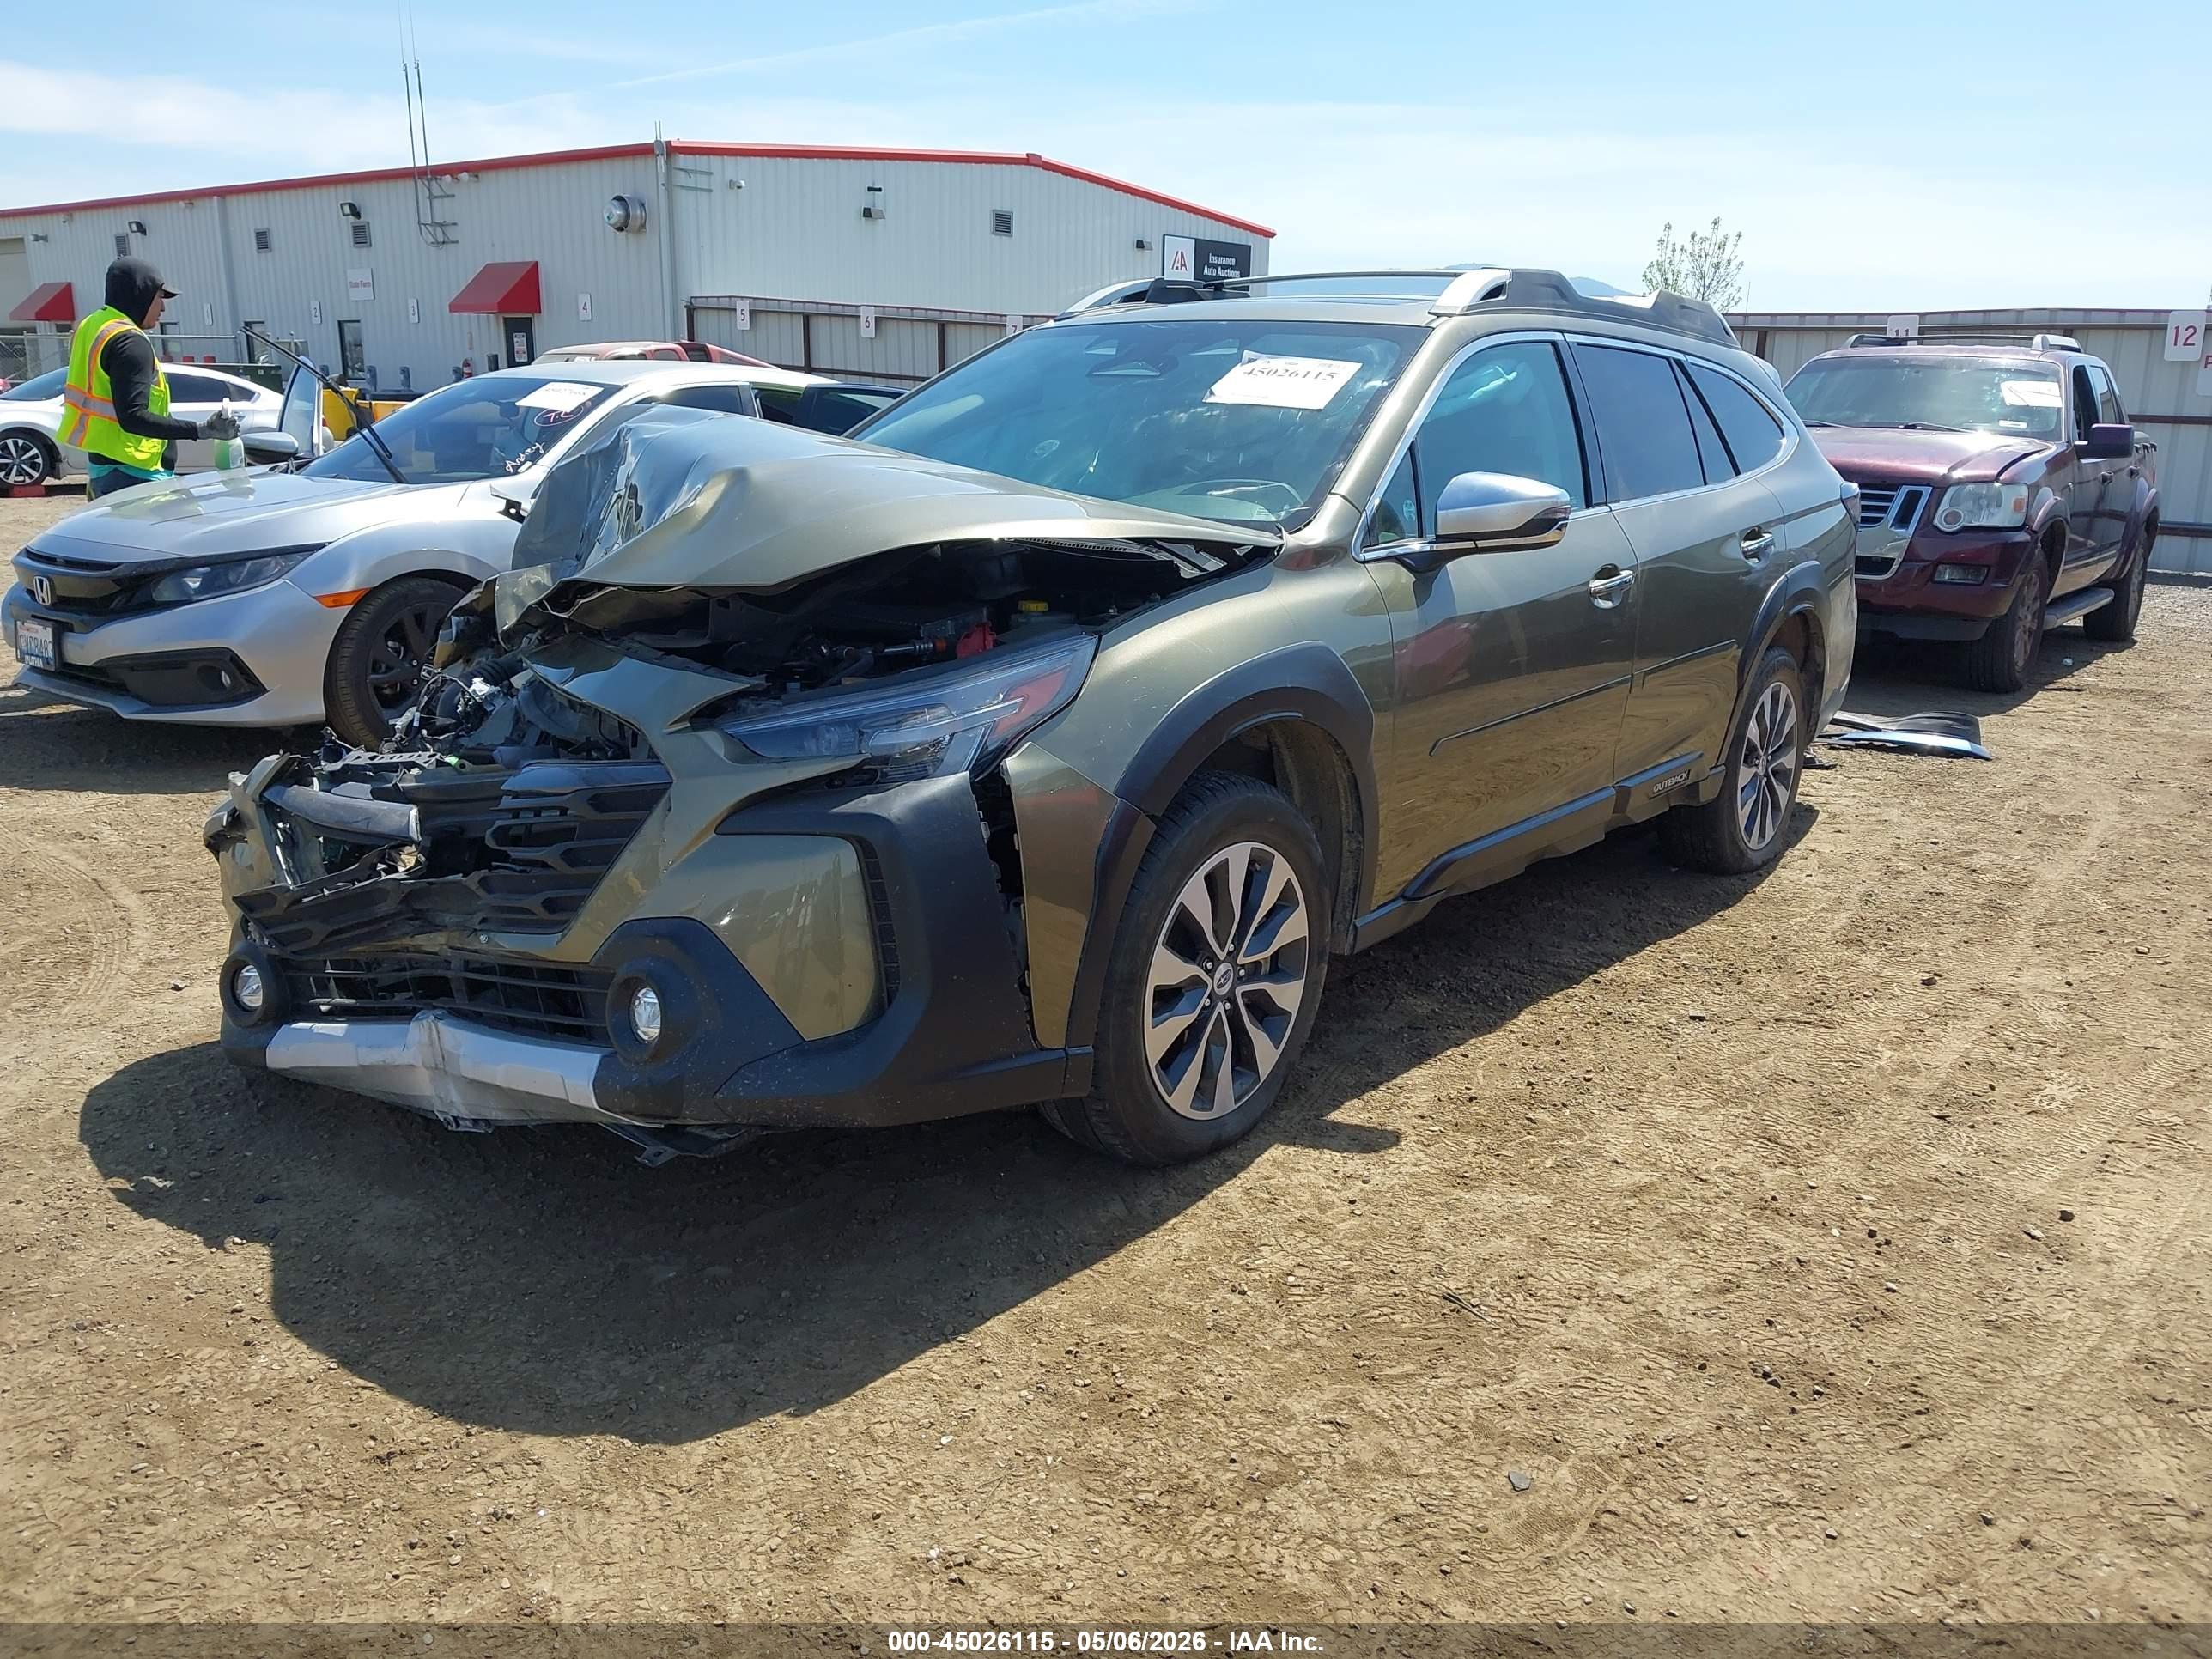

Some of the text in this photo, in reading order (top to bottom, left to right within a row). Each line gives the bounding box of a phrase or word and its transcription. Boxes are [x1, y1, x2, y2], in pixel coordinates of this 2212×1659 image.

[1209, 252, 1237, 266] Insurance
[1203, 264, 1241, 278] Auto Auctions
[313, 307, 319, 318] 2
[582, 301, 588, 313] 4
[740, 308, 746, 322] 5
[865, 315, 871, 329] 6
[1012, 325, 1018, 334] 7
[2172, 325, 2198, 347] 12
[1243, 367, 1338, 380] 45026115
[1653, 770, 1689, 792] OUTBACK
